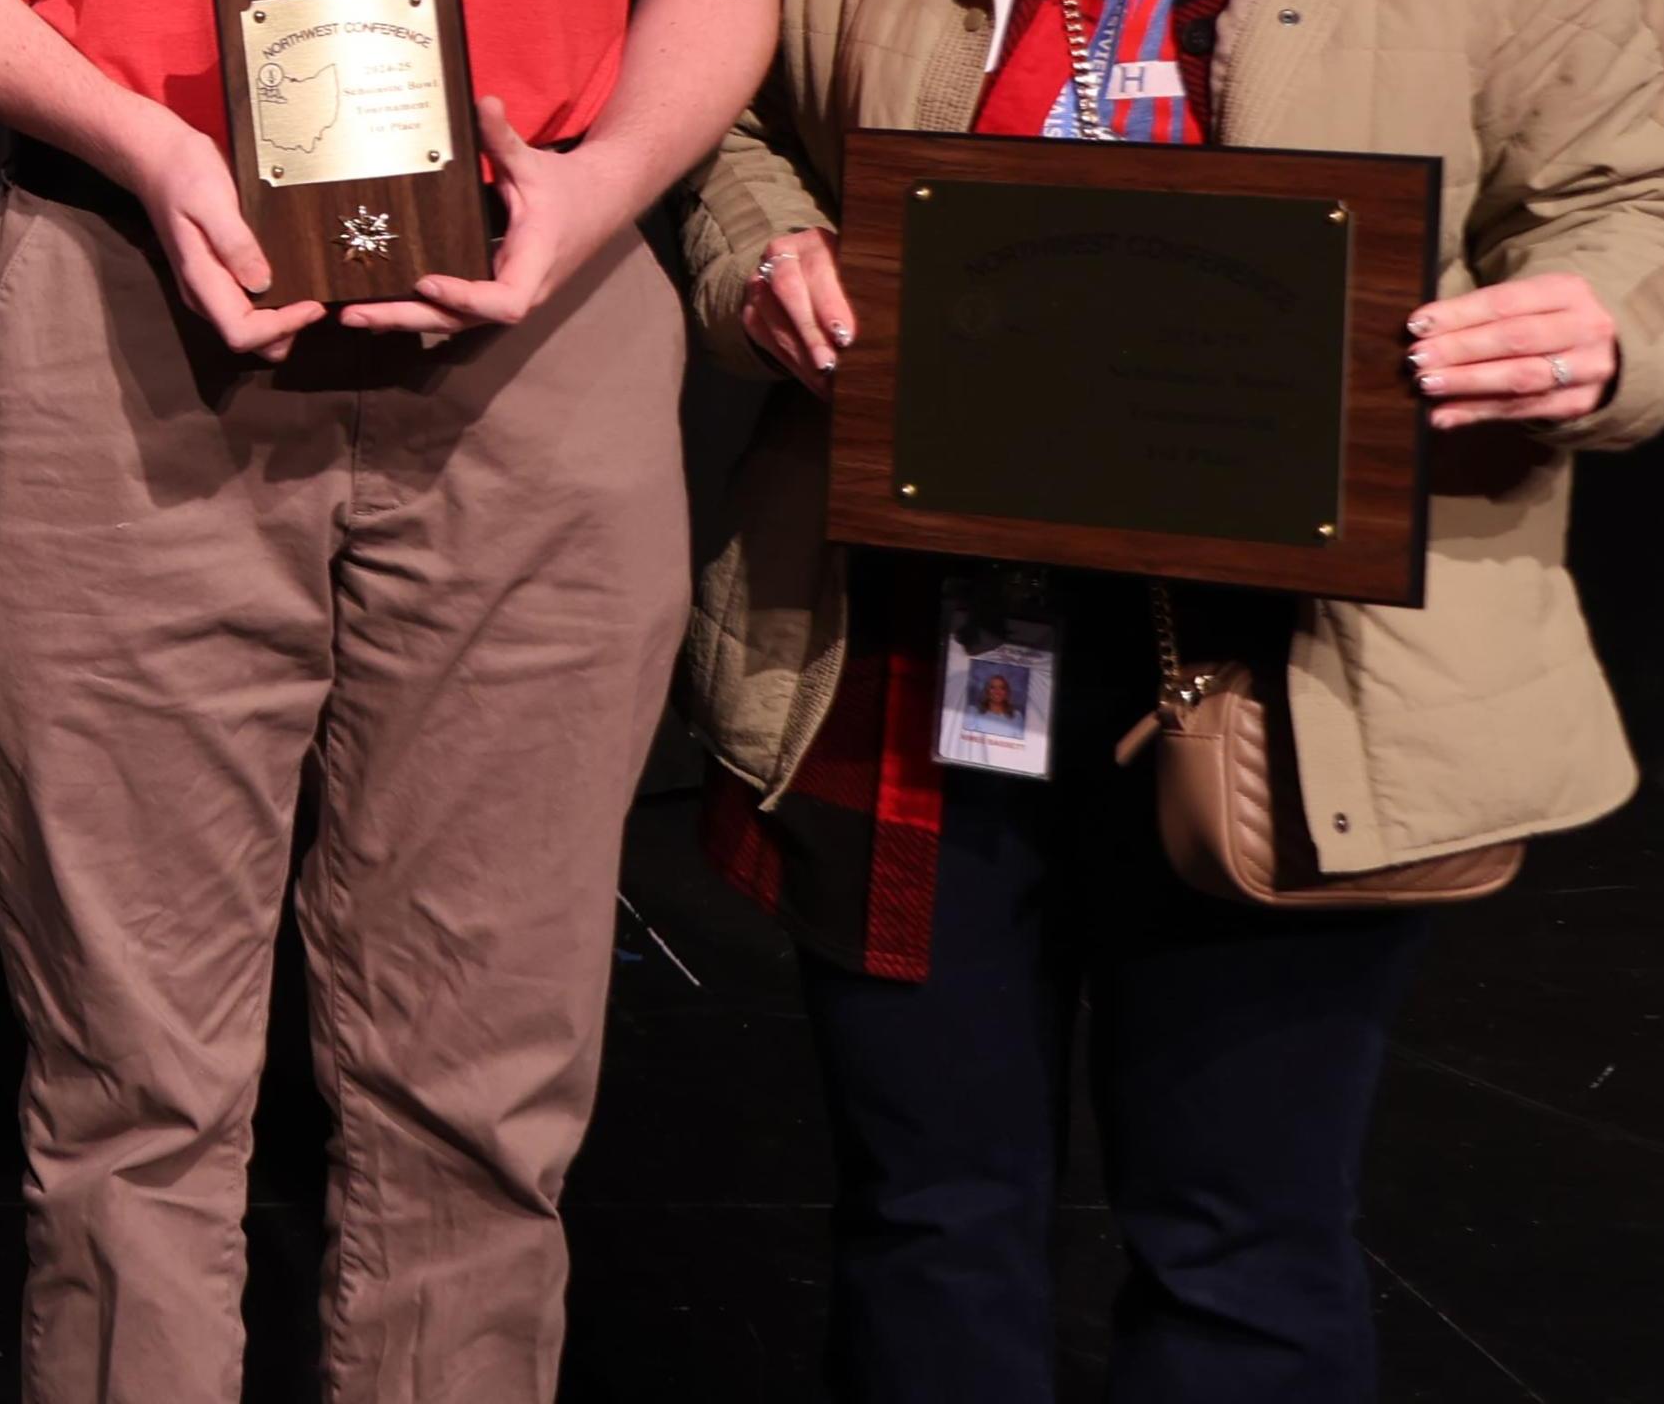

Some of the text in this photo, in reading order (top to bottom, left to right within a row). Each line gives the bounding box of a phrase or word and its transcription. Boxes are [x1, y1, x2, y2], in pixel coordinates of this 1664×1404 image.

[262, 22, 433, 60] NORTHWEST CONFERENCE
[1120, 66, 1144, 93] H
